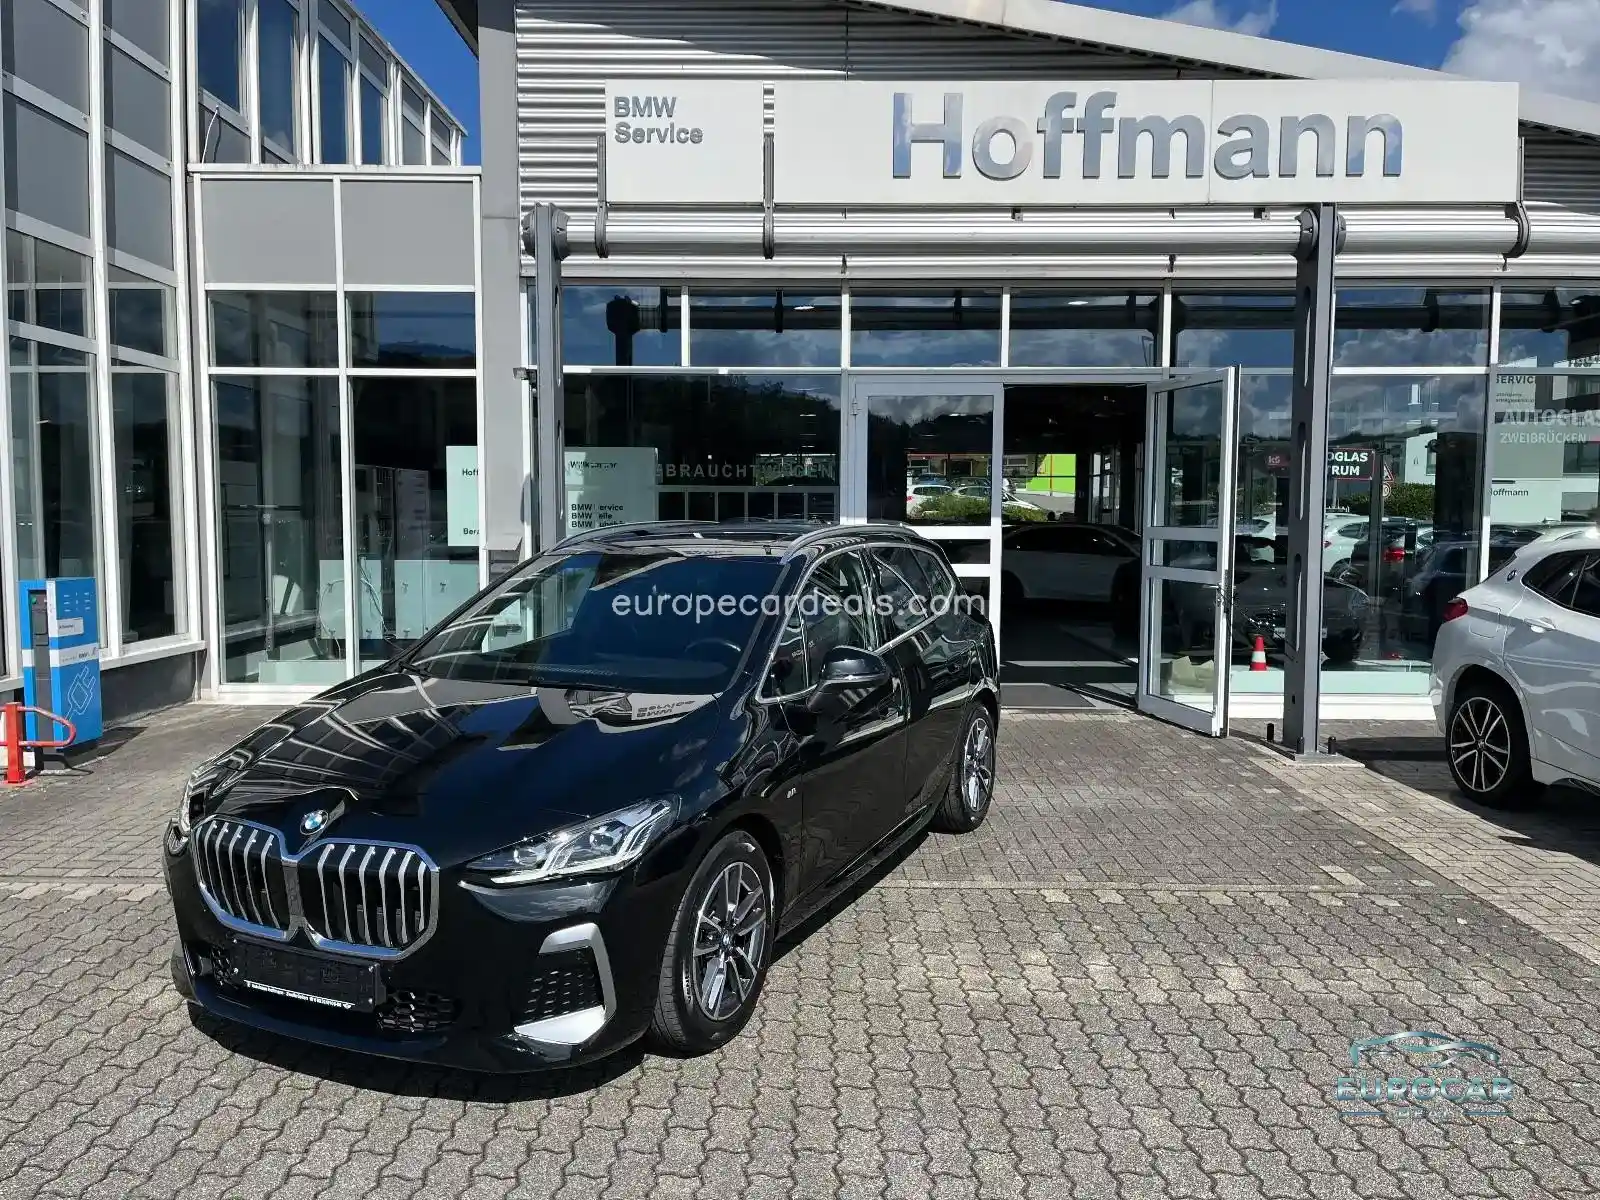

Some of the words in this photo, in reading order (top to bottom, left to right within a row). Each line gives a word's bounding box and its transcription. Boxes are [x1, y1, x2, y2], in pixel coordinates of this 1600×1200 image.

[613, 96, 677, 118] BMW
[614, 121, 704, 144] Service
[892, 90, 1403, 181] Hoffmann
[1500, 429, 1586, 444] ZWEIBRÜCKEN
[1329, 465, 1360, 476] RUM
[571, 503, 593, 511] BMW
[571, 512, 593, 520] BMW
[598, 512, 613, 520] eile
[571, 520, 593, 528] BMW
